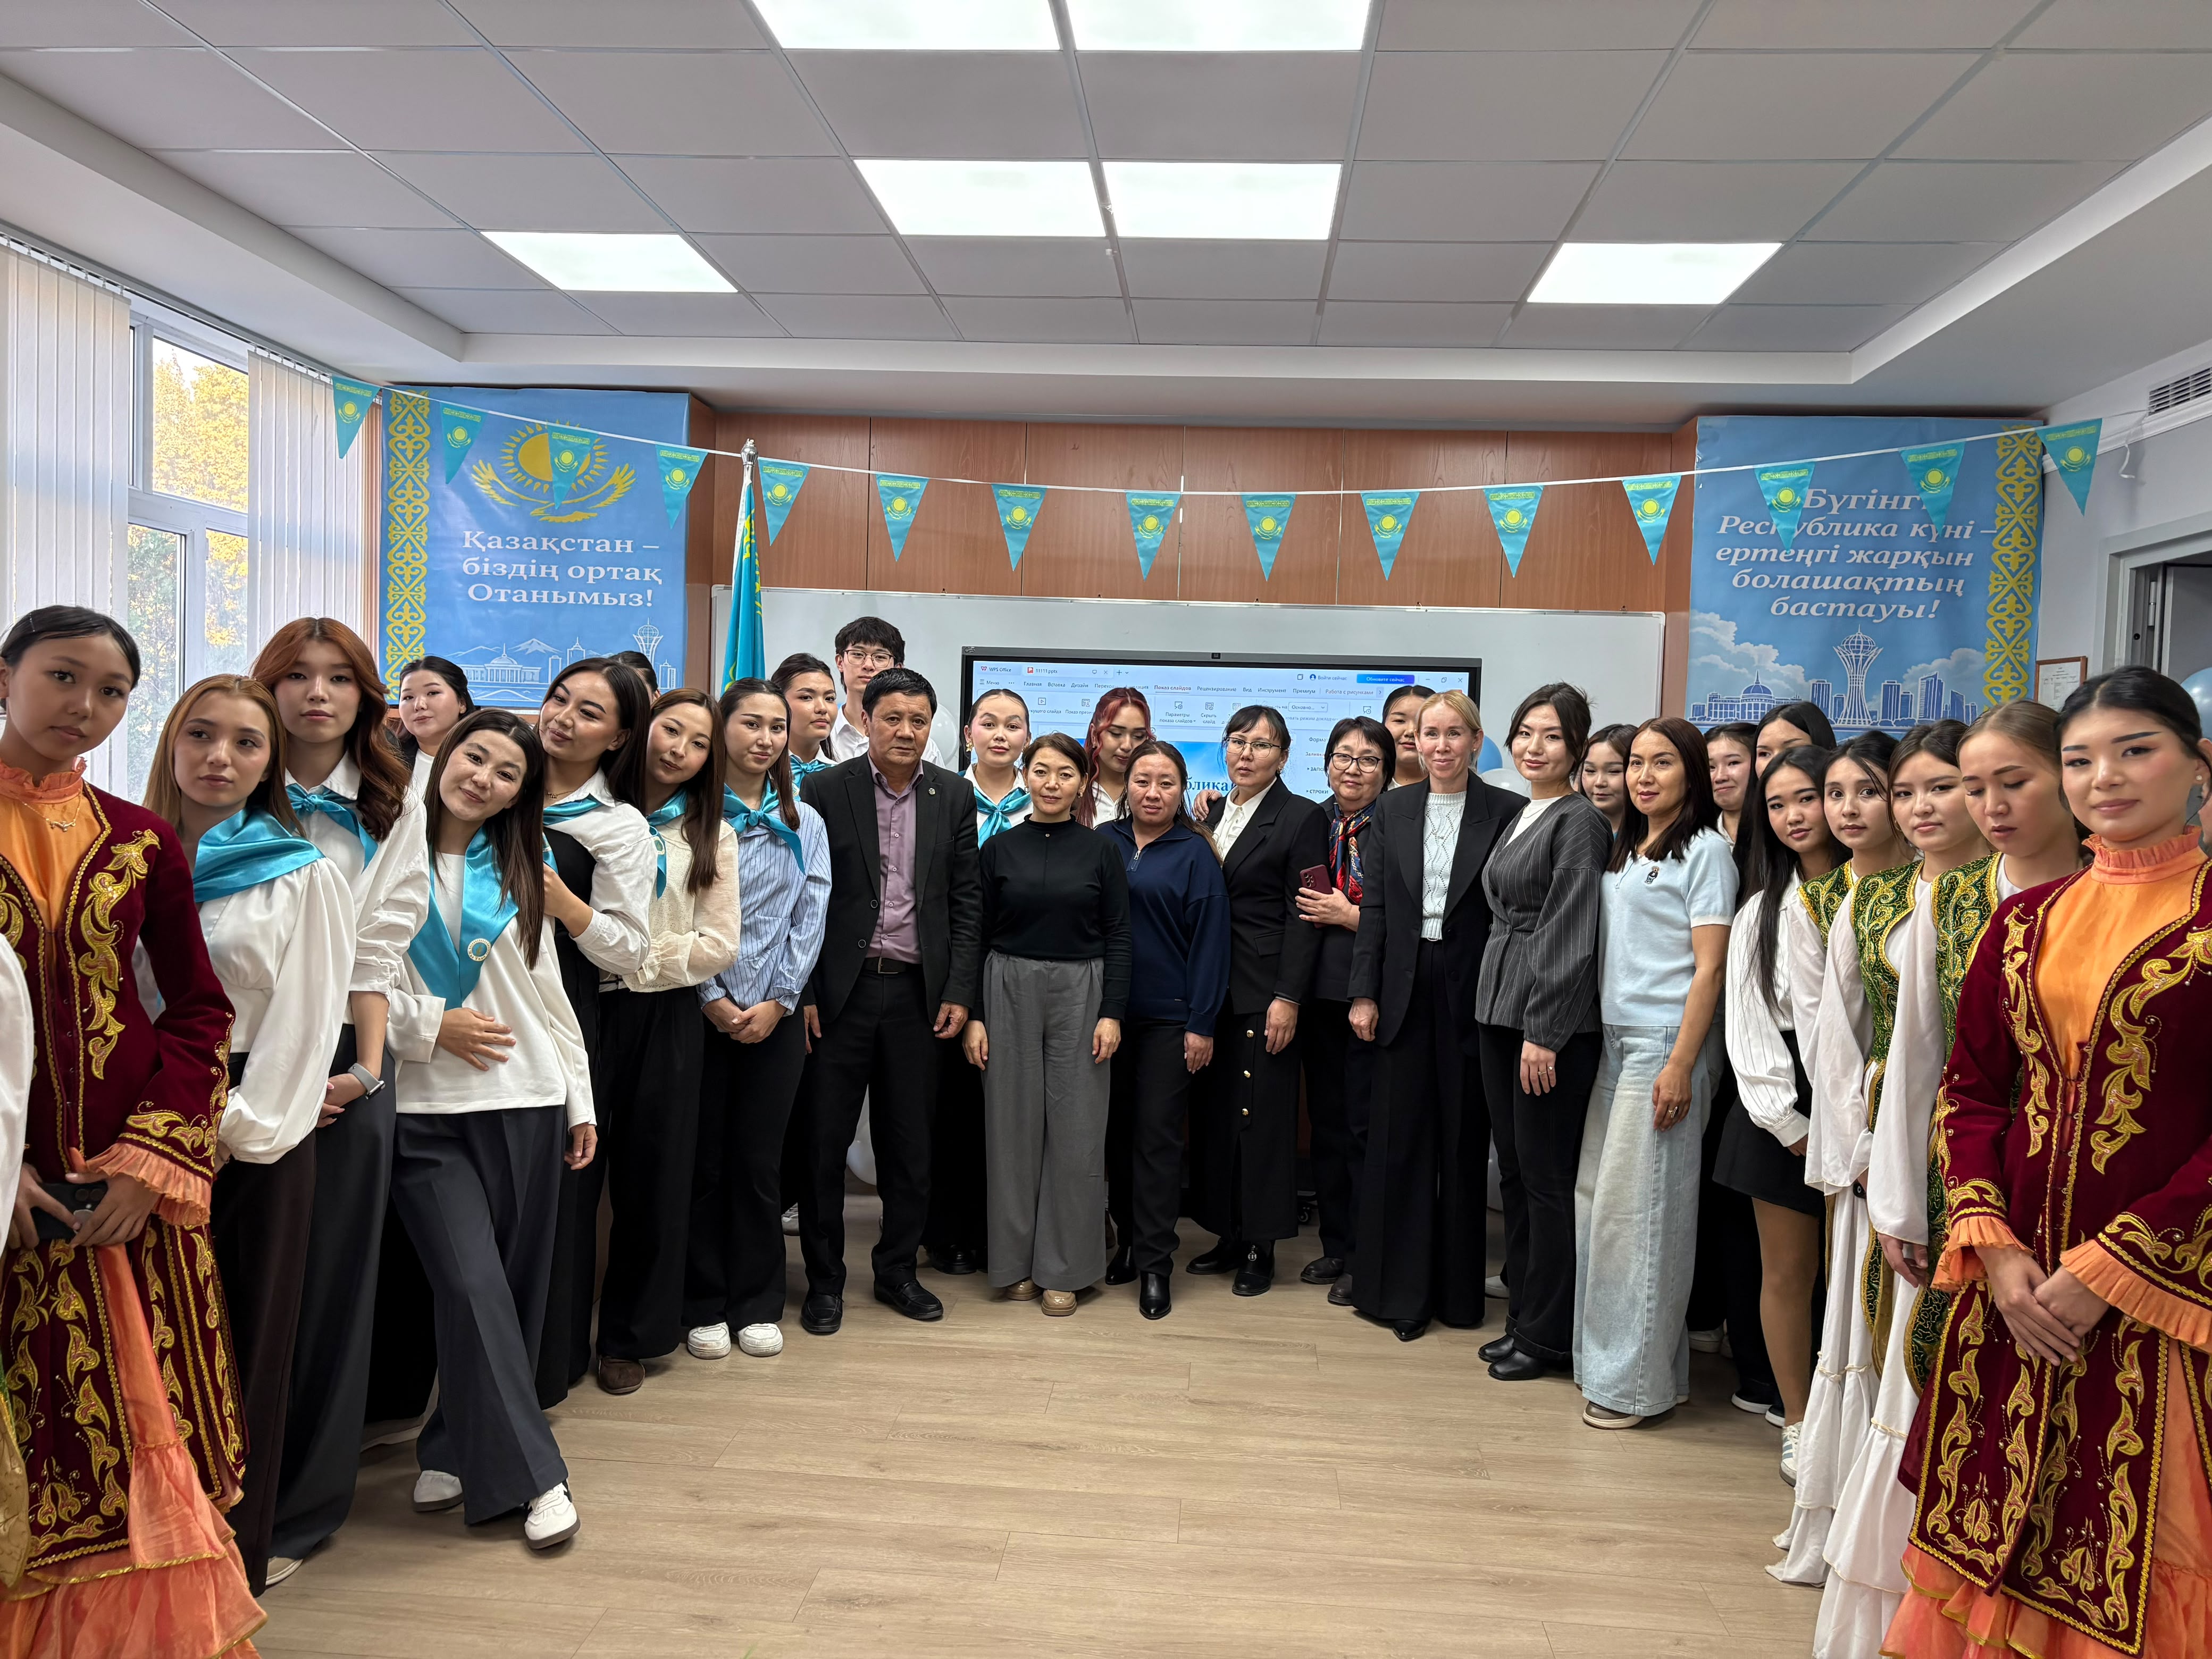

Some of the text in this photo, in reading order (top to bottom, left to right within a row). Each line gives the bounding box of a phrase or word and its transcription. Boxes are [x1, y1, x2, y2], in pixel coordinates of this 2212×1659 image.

[1803, 489, 1926, 515] Бүгінг
[462, 531, 633, 554] Қазақстан
[1909, 521, 1975, 542] күні
[1715, 544, 1974, 569] ертеңгі жарқын
[462, 557, 662, 585] біздің ортақ
[1732, 568, 1965, 597] болашақтың
[468, 583, 652, 607] Отанымыз!
[1770, 596, 1940, 623] бастауы!
